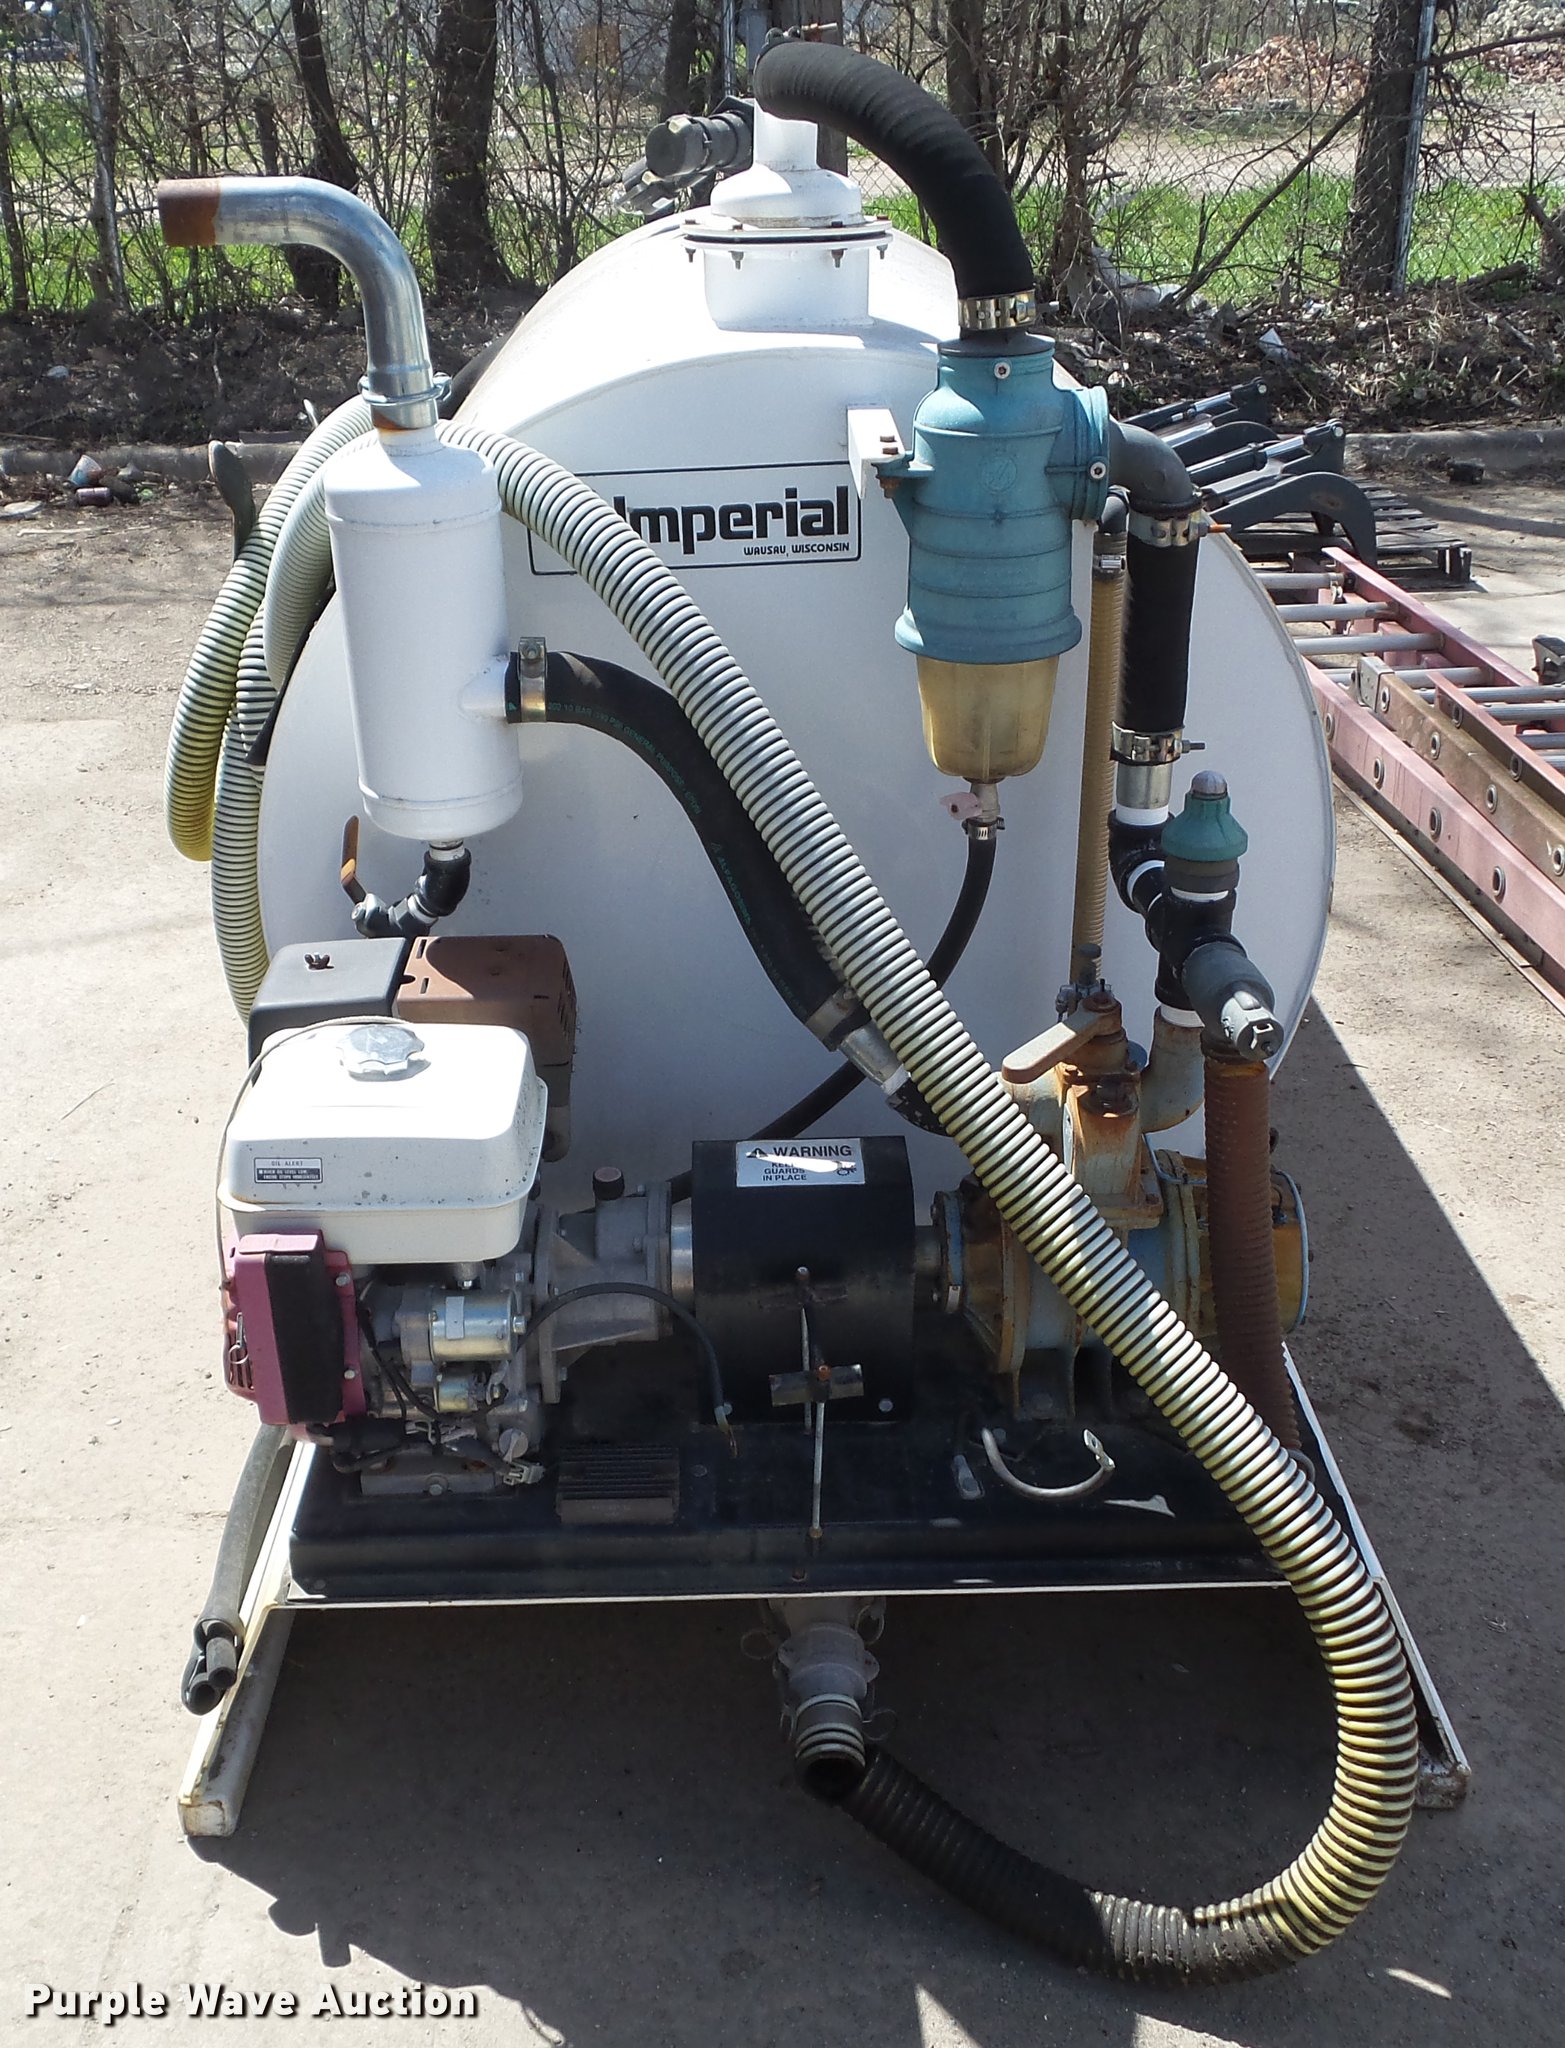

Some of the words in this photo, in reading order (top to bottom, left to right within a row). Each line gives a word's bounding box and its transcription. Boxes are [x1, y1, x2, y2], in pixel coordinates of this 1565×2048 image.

[612, 485, 849, 554] Imperial
[743, 546, 789, 558] WAUSAU,
[791, 542, 850, 555] WISCONSIN
[574, 705, 592, 716] BAR
[623, 727, 656, 754] GENERAL
[773, 1145, 852, 1157] WARNING
